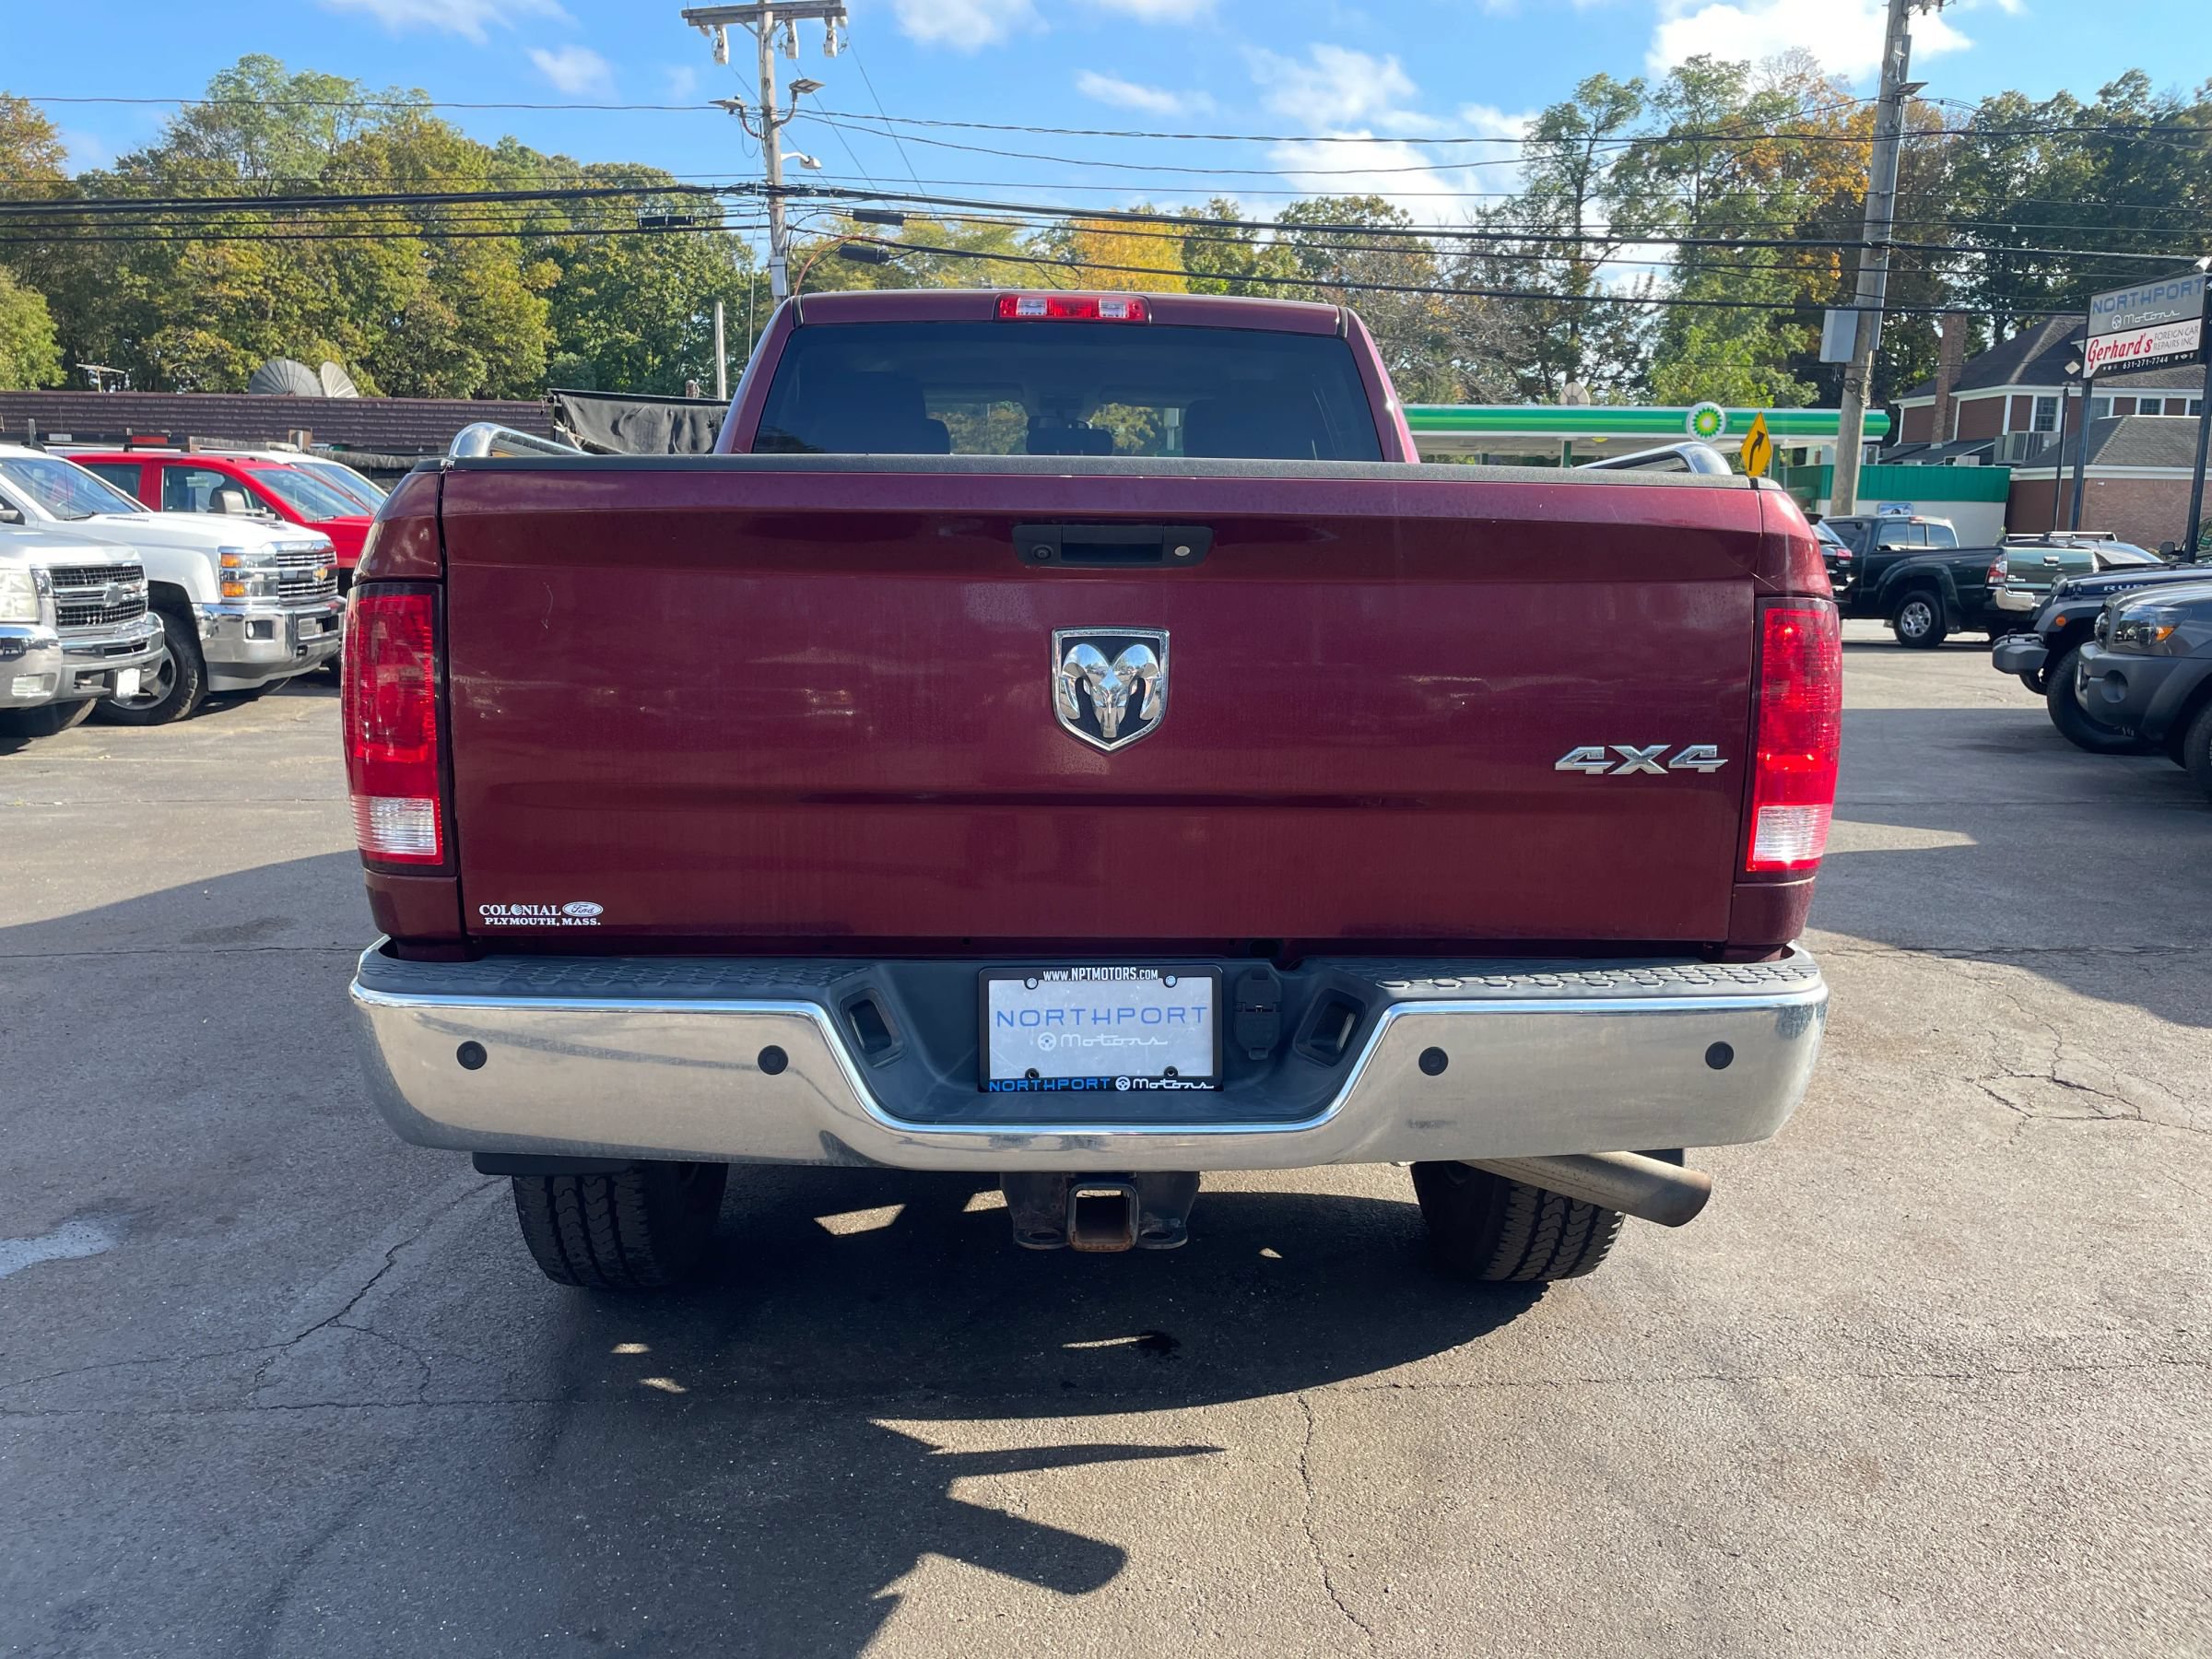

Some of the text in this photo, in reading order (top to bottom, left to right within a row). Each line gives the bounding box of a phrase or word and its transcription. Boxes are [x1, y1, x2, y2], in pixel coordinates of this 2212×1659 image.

[2092, 278, 2205, 314] NORTHPORT
[2123, 310, 2181, 325] Motors
[2154, 325, 2199, 341] FOREIGN CAR
[2088, 333, 2153, 370] Gerhard's
[2153, 338, 2180, 350] REPAIRS
[2123, 356, 2169, 370] 631-271-7744
[1554, 744, 1729, 775] 4X4
[478, 902, 597, 916] COLONIAL Ford
[484, 917, 601, 926] PLYMOUTH, MASS.
[1042, 967, 1159, 982] WWW.NPTMOTORS.COM
[996, 1006, 1207, 1028] NORTHPORT
[1060, 1032, 1169, 1048] Motors
[989, 1077, 1215, 1092] NORTHPORT Motors
